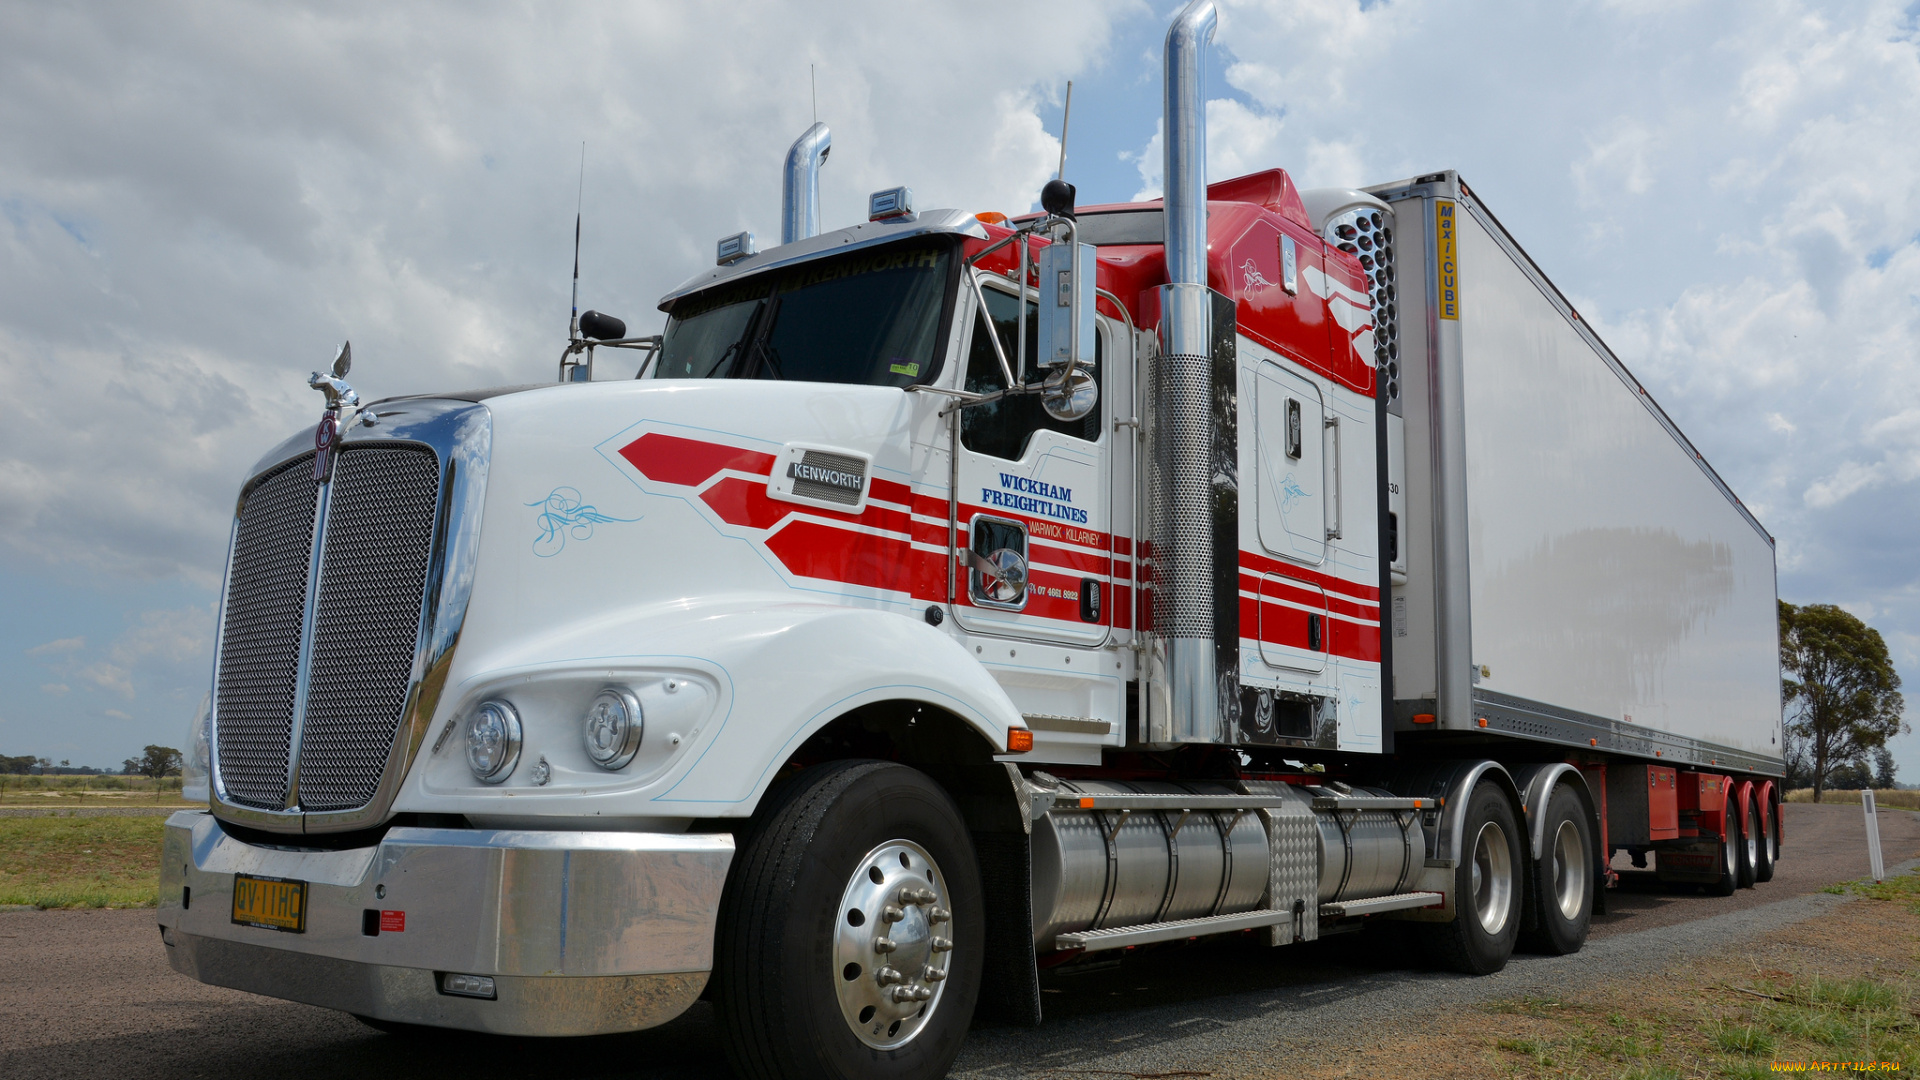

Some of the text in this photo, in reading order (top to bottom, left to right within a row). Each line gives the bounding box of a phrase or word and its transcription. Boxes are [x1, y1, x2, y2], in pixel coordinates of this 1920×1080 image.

[794, 464, 861, 489] KENWORTH
[999, 472, 1072, 503] WICKHAM
[982, 488, 1088, 524] FREIGHTLINES
[1029, 520, 1100, 546] WARWICK KILLARNEY
[1037, 585, 1046, 596] 07
